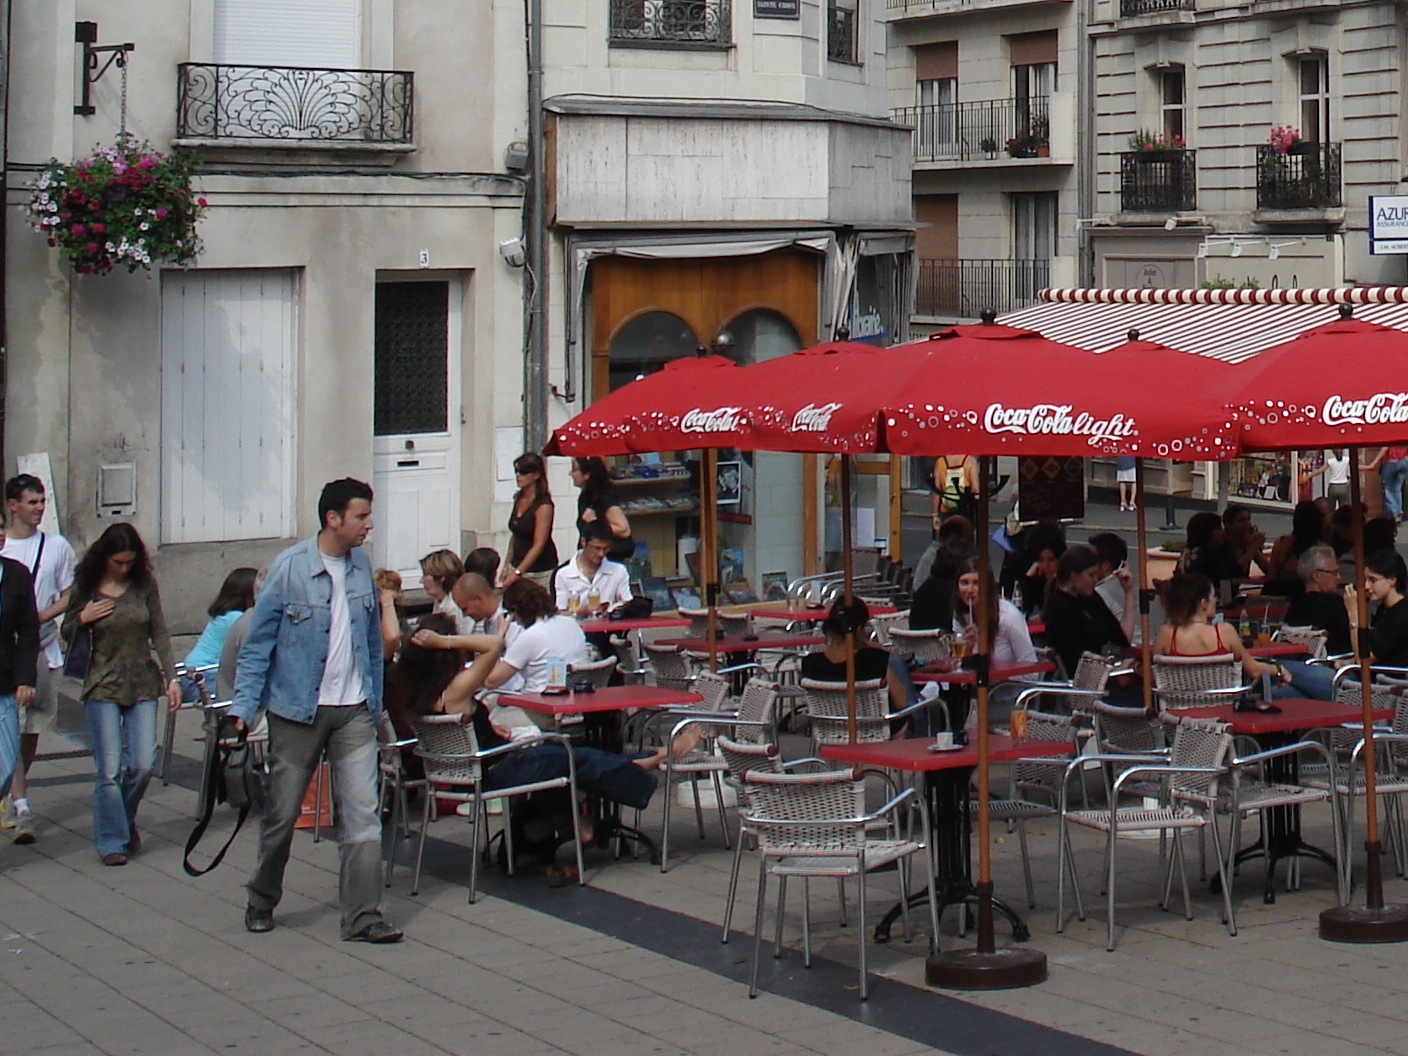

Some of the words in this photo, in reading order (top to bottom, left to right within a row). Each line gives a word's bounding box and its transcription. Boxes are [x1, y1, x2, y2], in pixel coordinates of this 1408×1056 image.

[421, 253, 428, 264] 3
[984, 403, 1073, 435] Coca-Cola
[1072, 412, 1138, 445] light
